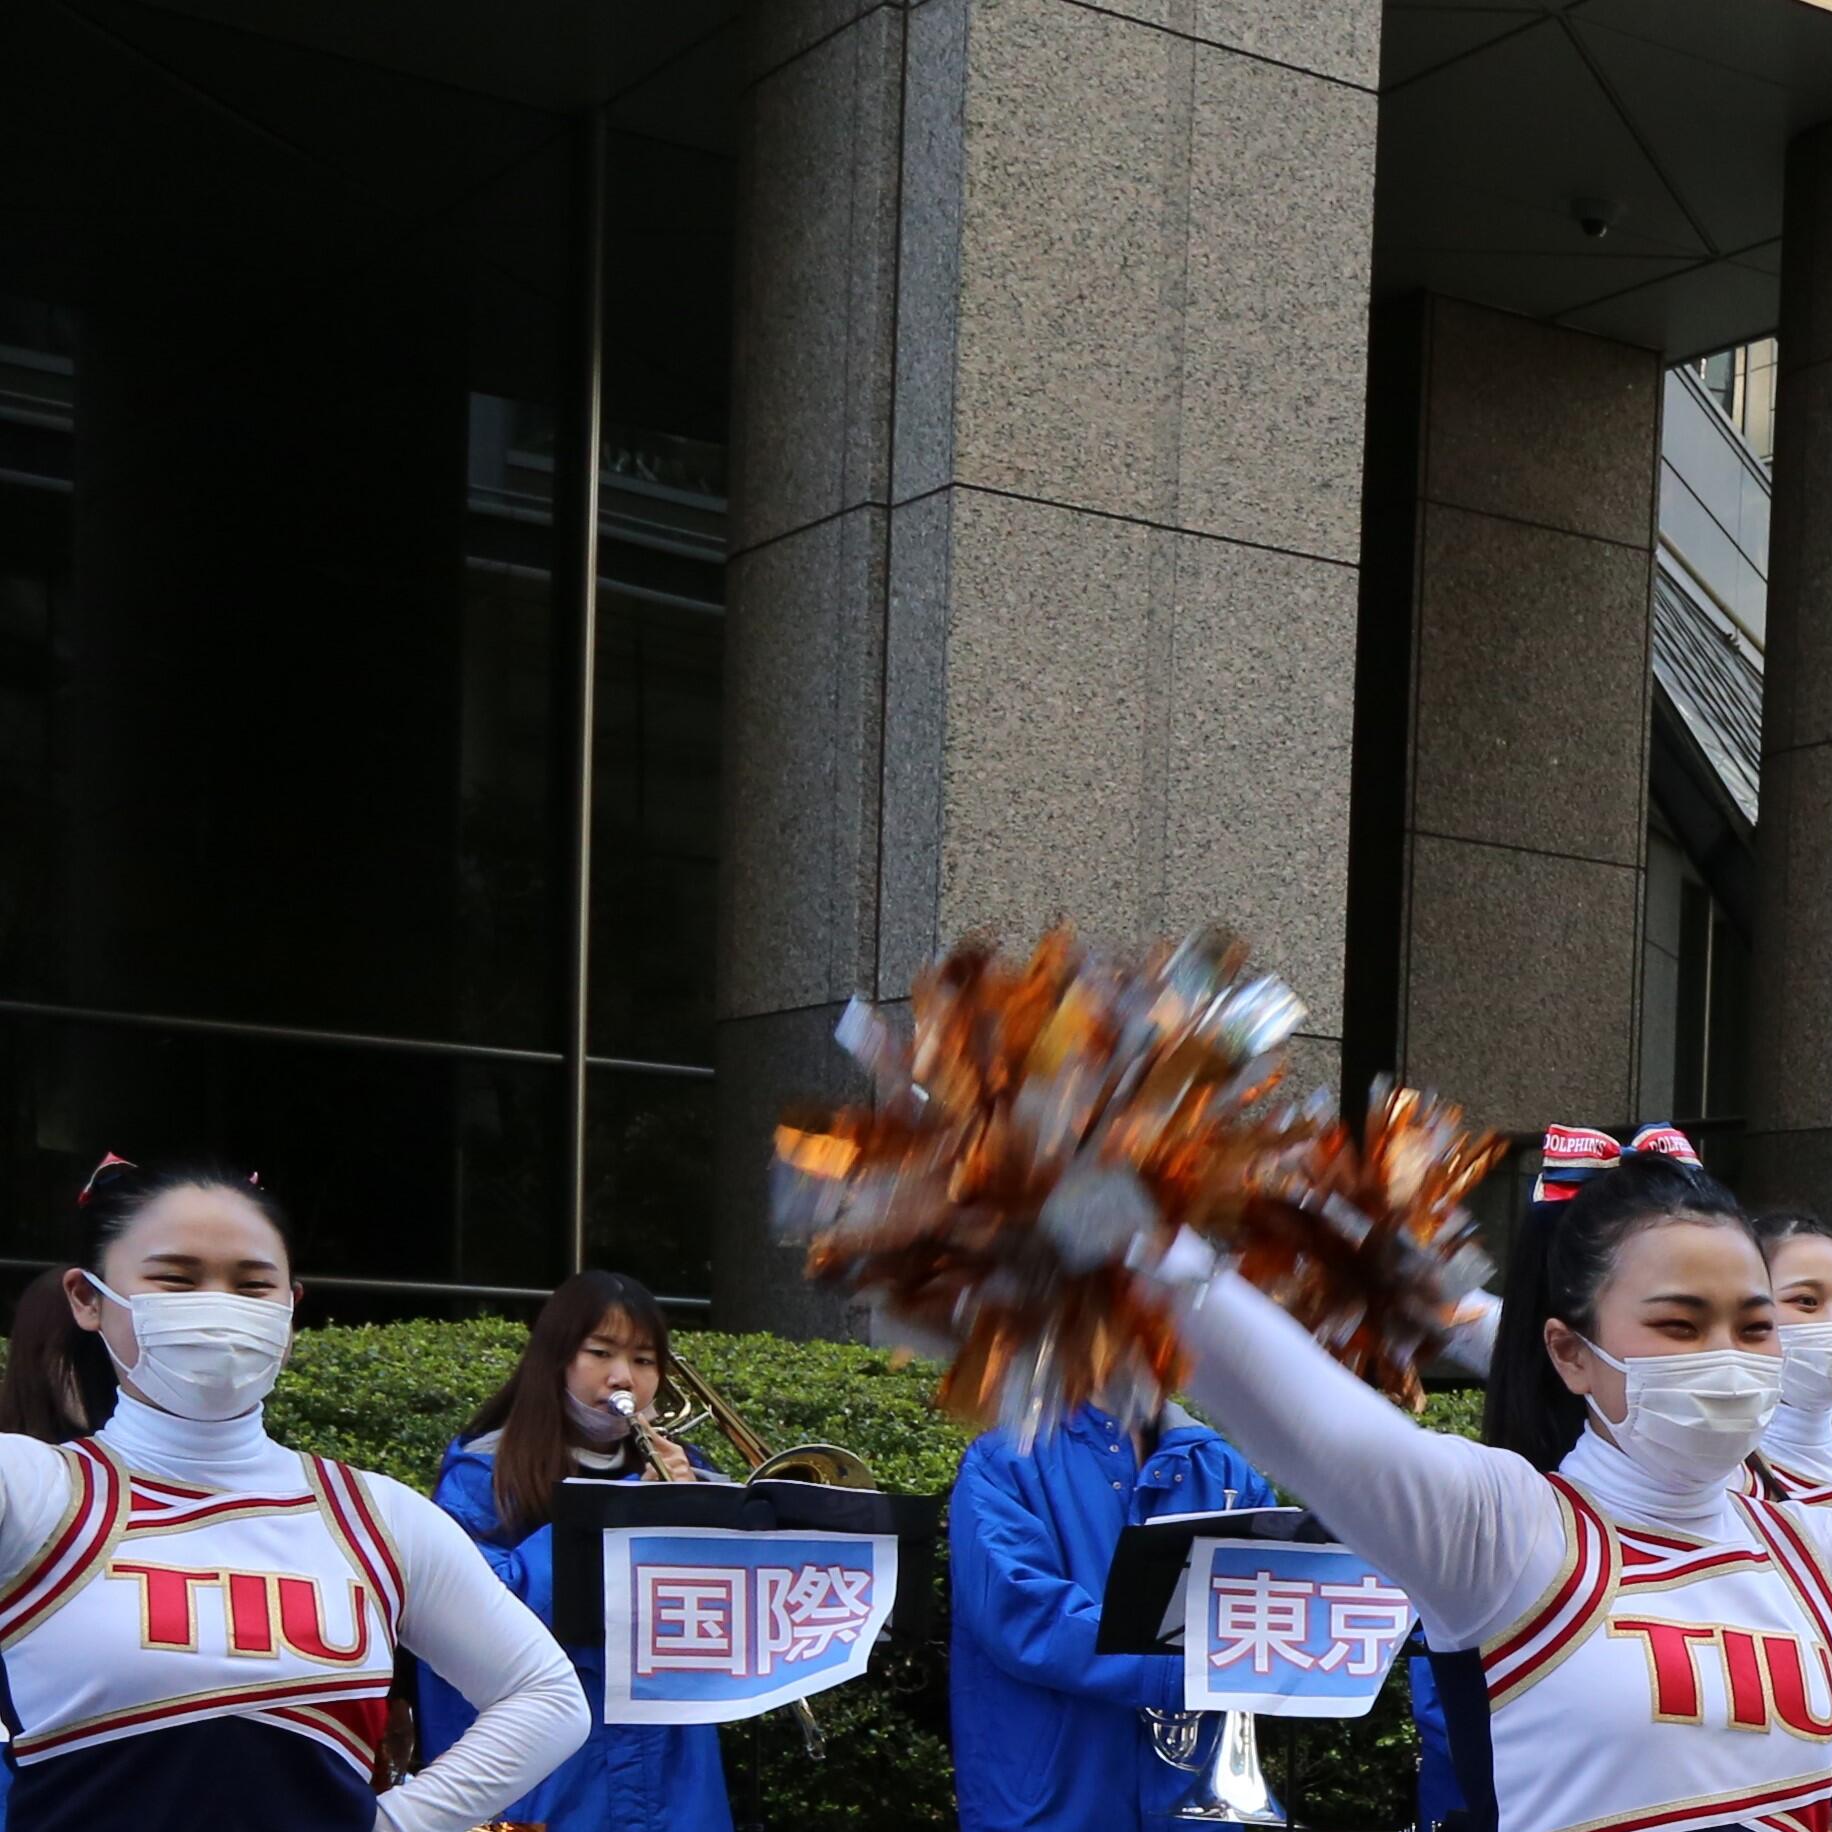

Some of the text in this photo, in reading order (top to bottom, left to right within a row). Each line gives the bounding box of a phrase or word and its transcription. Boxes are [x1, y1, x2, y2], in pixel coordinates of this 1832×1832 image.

[105, 1560, 370, 1668] TIU
[634, 1562, 874, 1681] 国際
[1209, 1570, 1412, 1676] 東京
